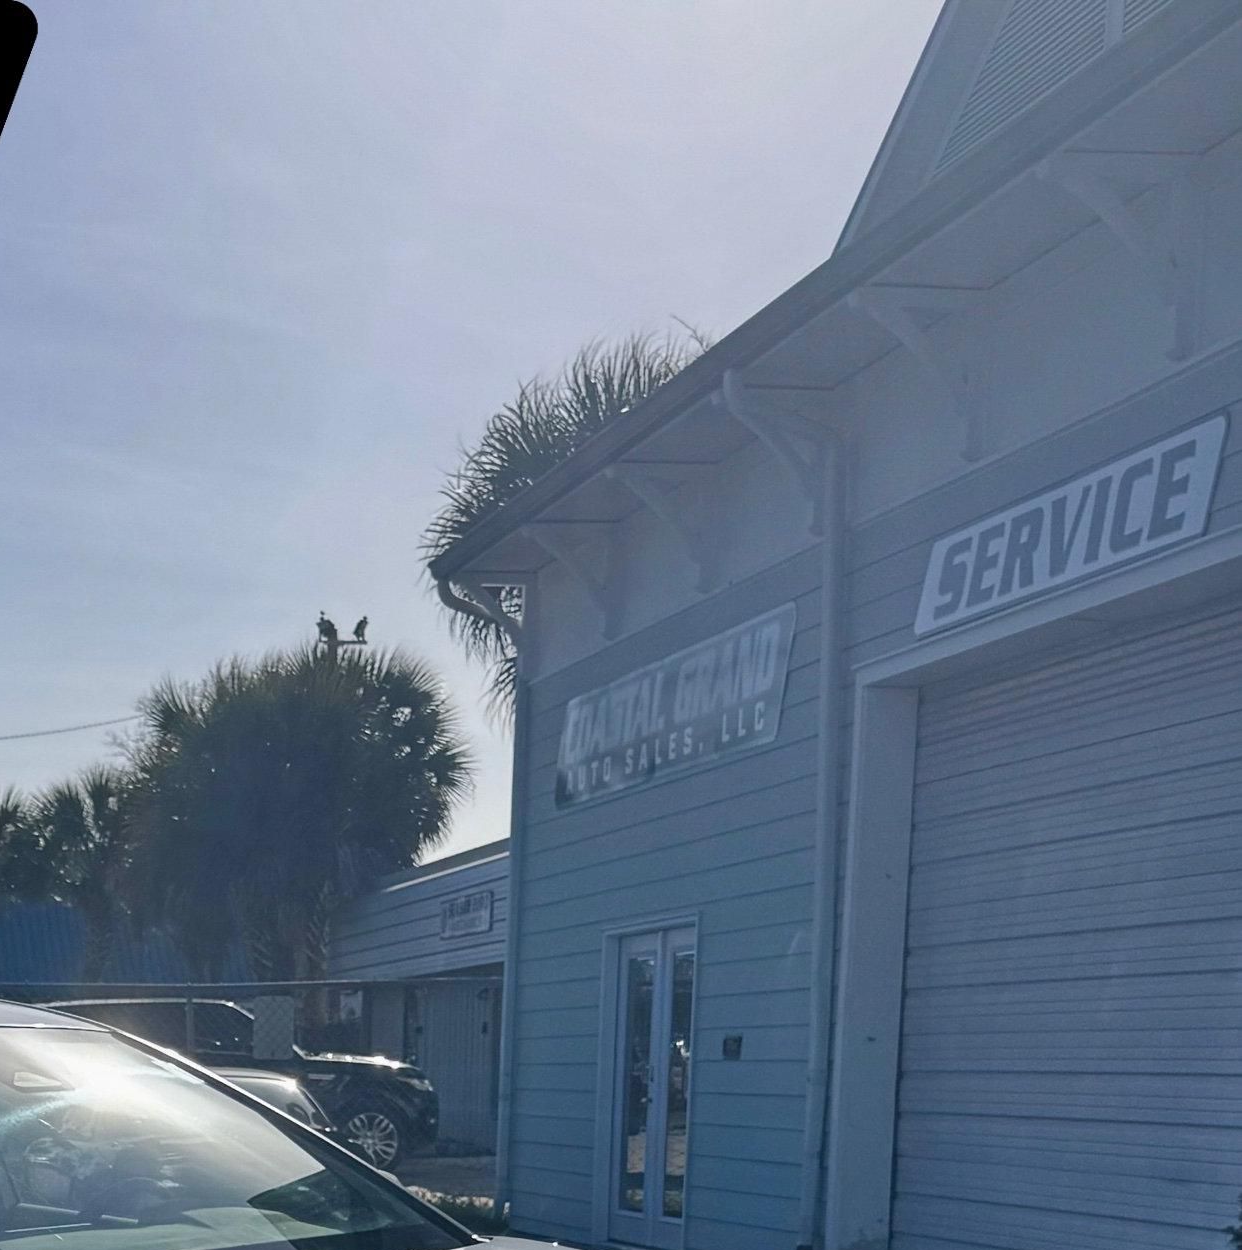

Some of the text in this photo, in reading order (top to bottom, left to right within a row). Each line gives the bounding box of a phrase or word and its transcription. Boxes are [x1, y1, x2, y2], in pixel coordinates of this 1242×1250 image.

[933, 439, 1196, 620] SERVICE
[674, 622, 781, 724] GRAND
[567, 701, 766, 793] AUTO SALES, LLC
